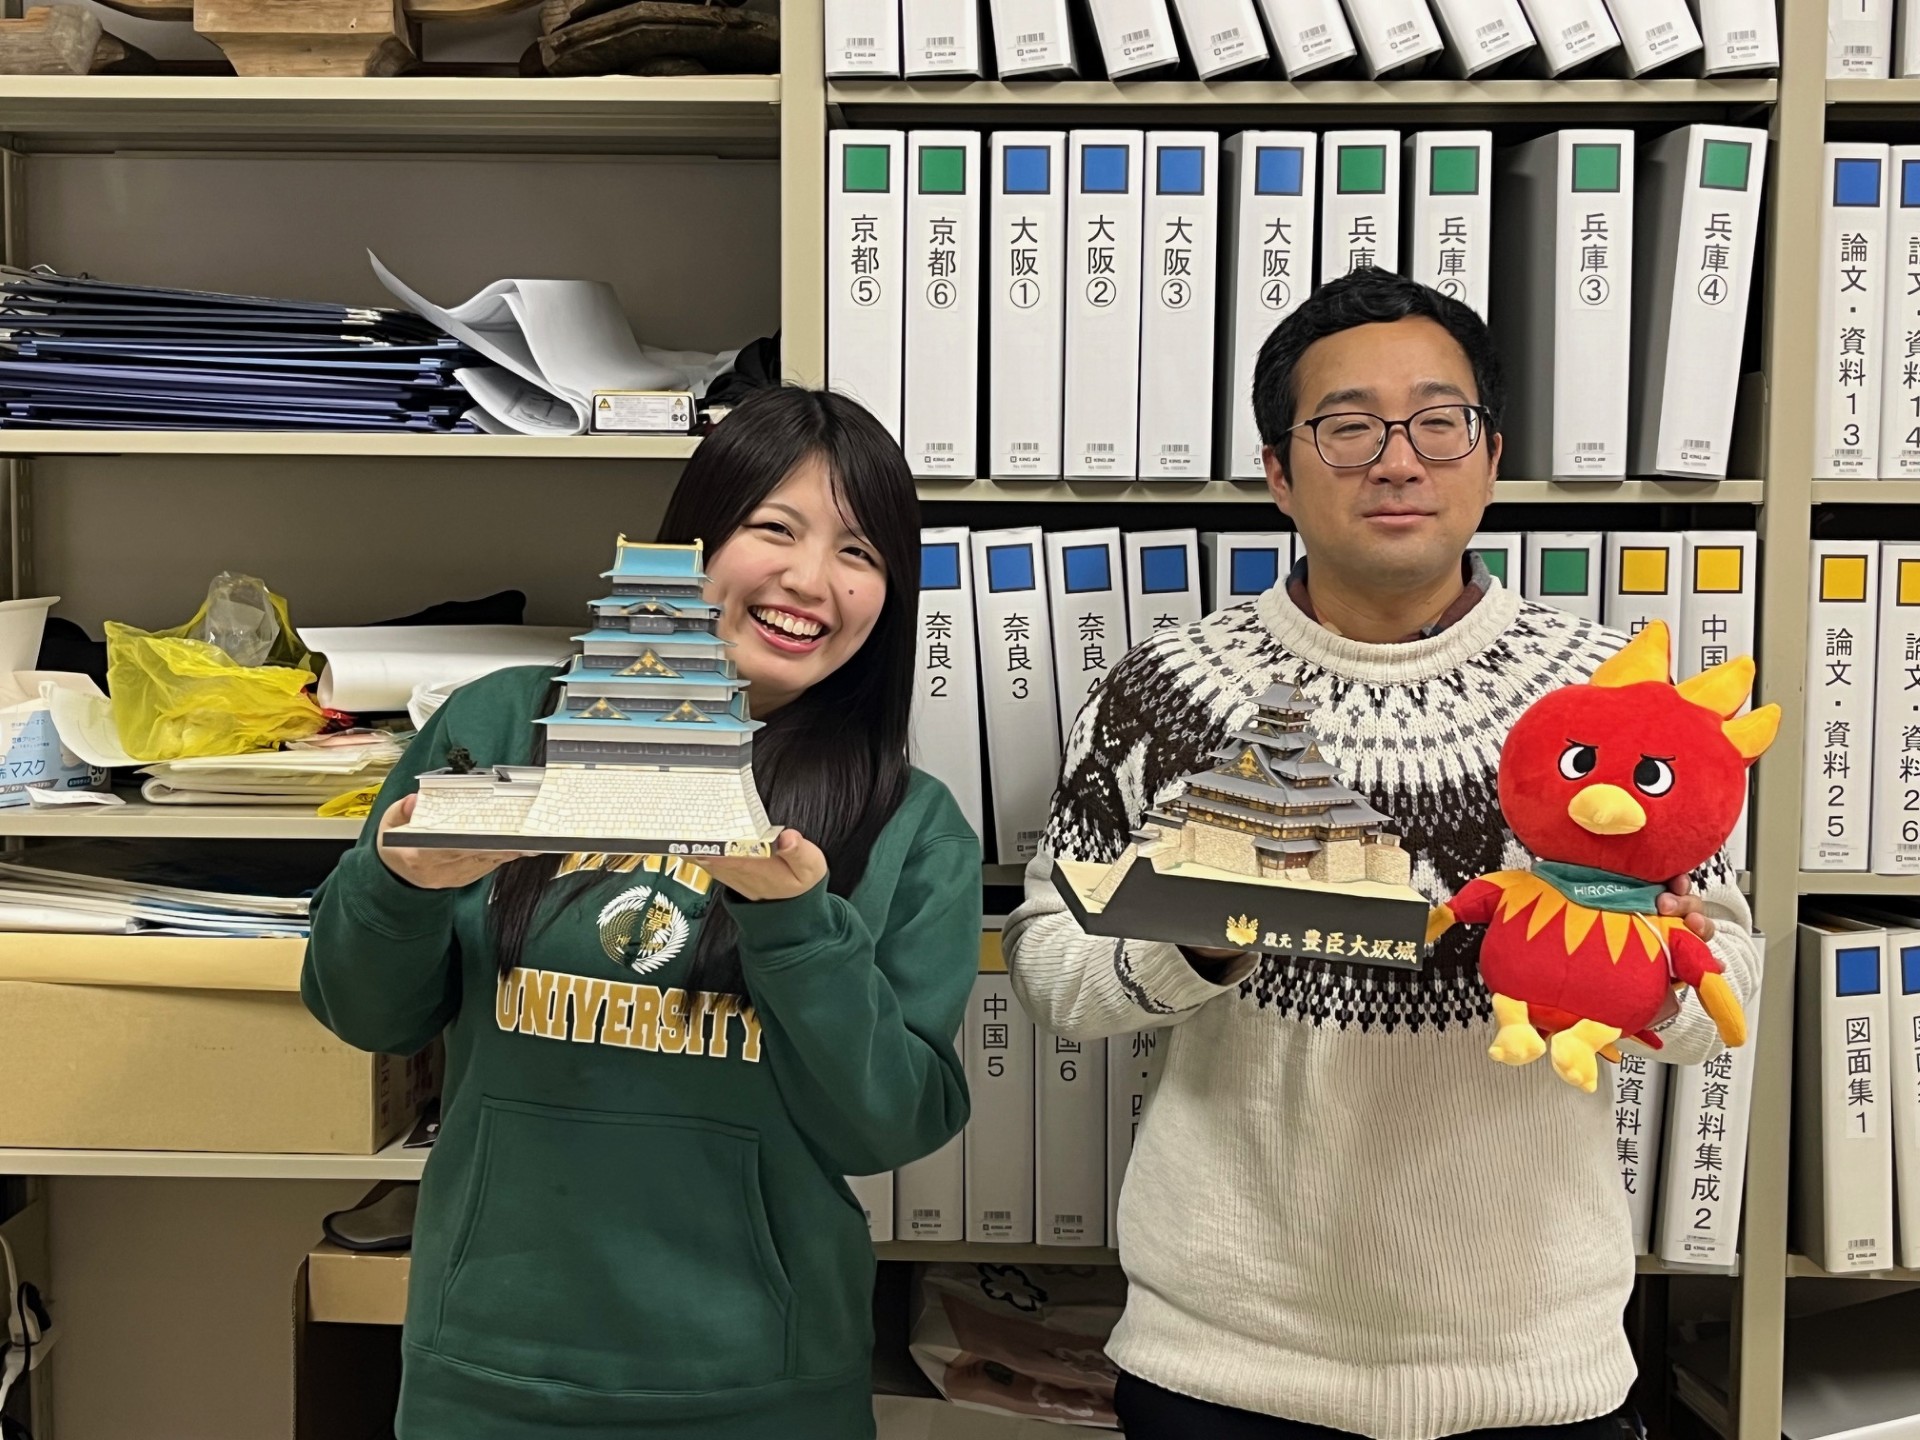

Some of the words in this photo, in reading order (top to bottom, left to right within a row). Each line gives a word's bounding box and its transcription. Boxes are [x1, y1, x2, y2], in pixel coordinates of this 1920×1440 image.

[851, 214, 881, 306] 京都⑤
[926, 217, 957, 309] 京都⑥
[1009, 217, 1040, 309] 大阪①
[1086, 215, 1117, 308] 大阪②
[1160, 217, 1193, 309] 大阪③
[1260, 218, 1292, 310] 大阪④
[1579, 213, 1610, 306] 兵庫③
[1697, 213, 1732, 306] 兵庫④
[1838, 233, 1868, 446] 論文・資料13
[926, 611, 953, 698] 奈良2
[1003, 613, 1032, 700] 奈良3
[1823, 628, 1853, 838] 論文・資料25
[496, 966, 762, 1063] UNIVERSITY
[983, 993, 1009, 1078] 中国5
[1846, 1017, 1874, 1133] 図面集1
